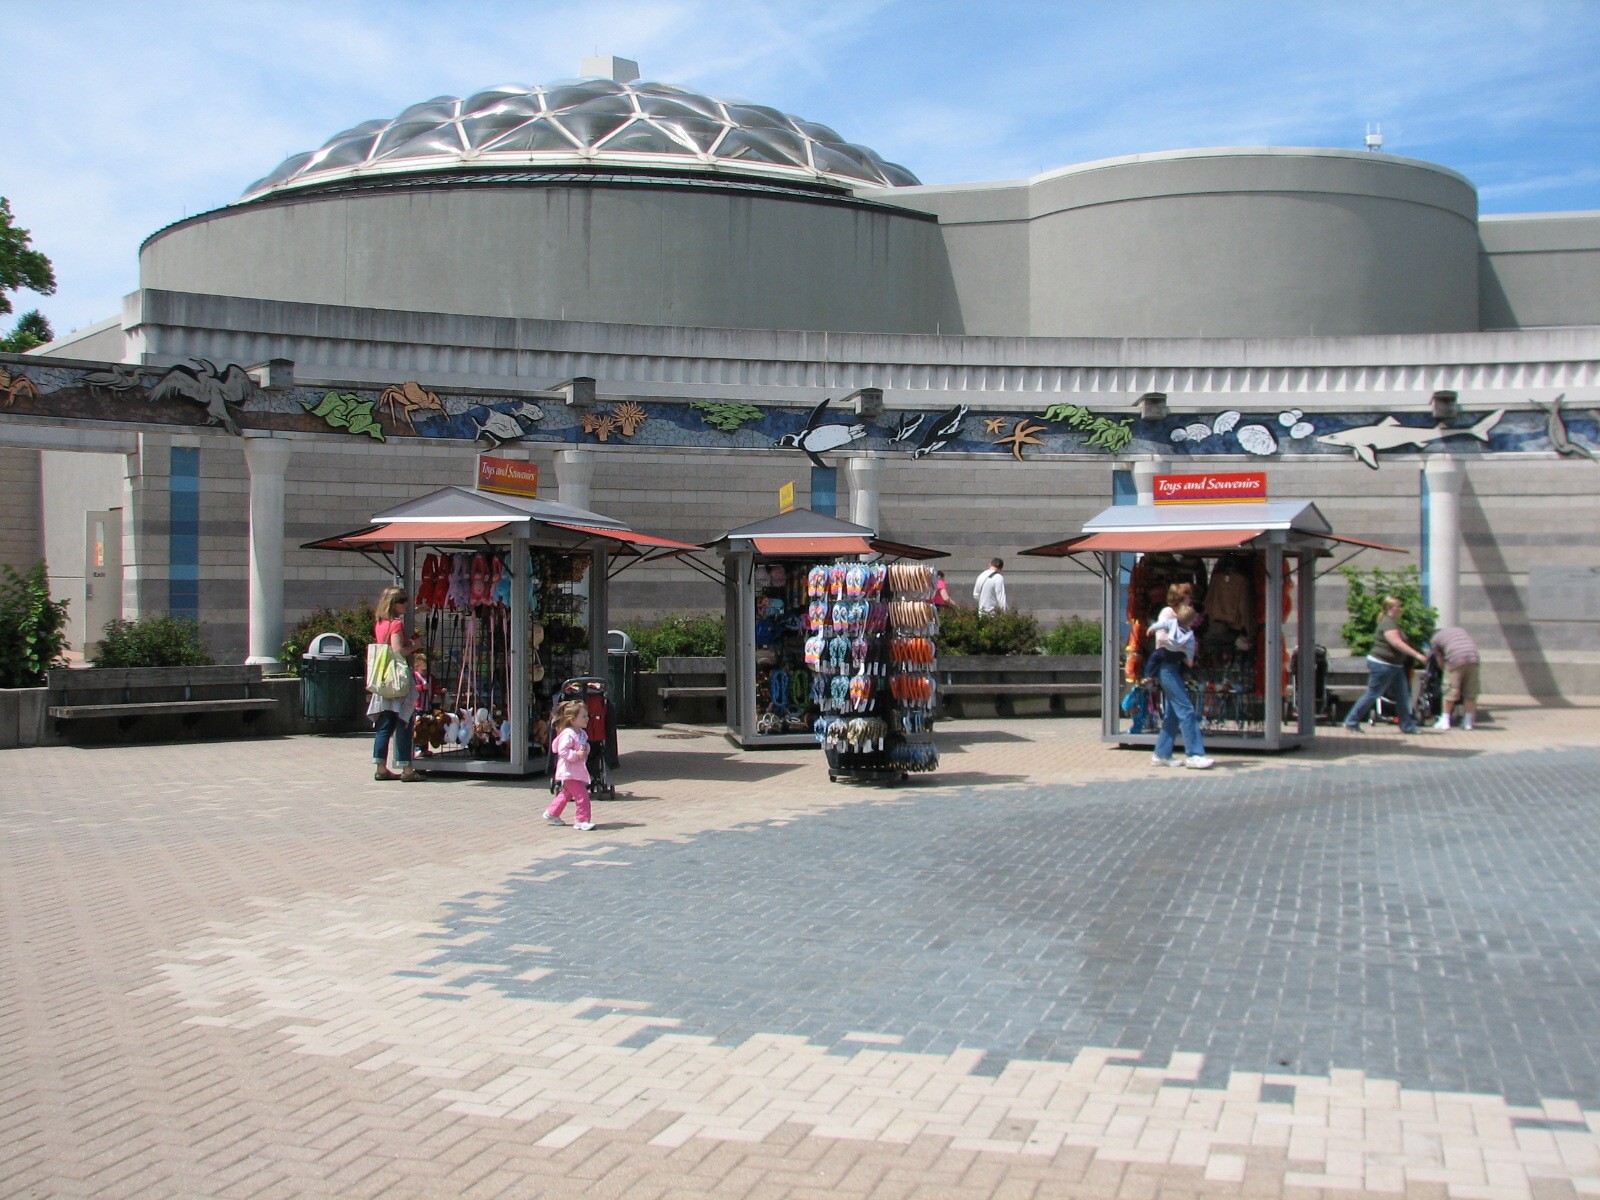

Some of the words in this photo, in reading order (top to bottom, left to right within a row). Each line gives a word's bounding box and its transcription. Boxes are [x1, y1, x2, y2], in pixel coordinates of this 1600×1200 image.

[482, 462, 495, 479] Toys
[496, 464, 509, 476] and
[508, 466, 535, 481] Souvenirs
[1159, 480, 1182, 495] Toys
[1184, 477, 1207, 490] and
[1207, 478, 1260, 490] Souvenirs
